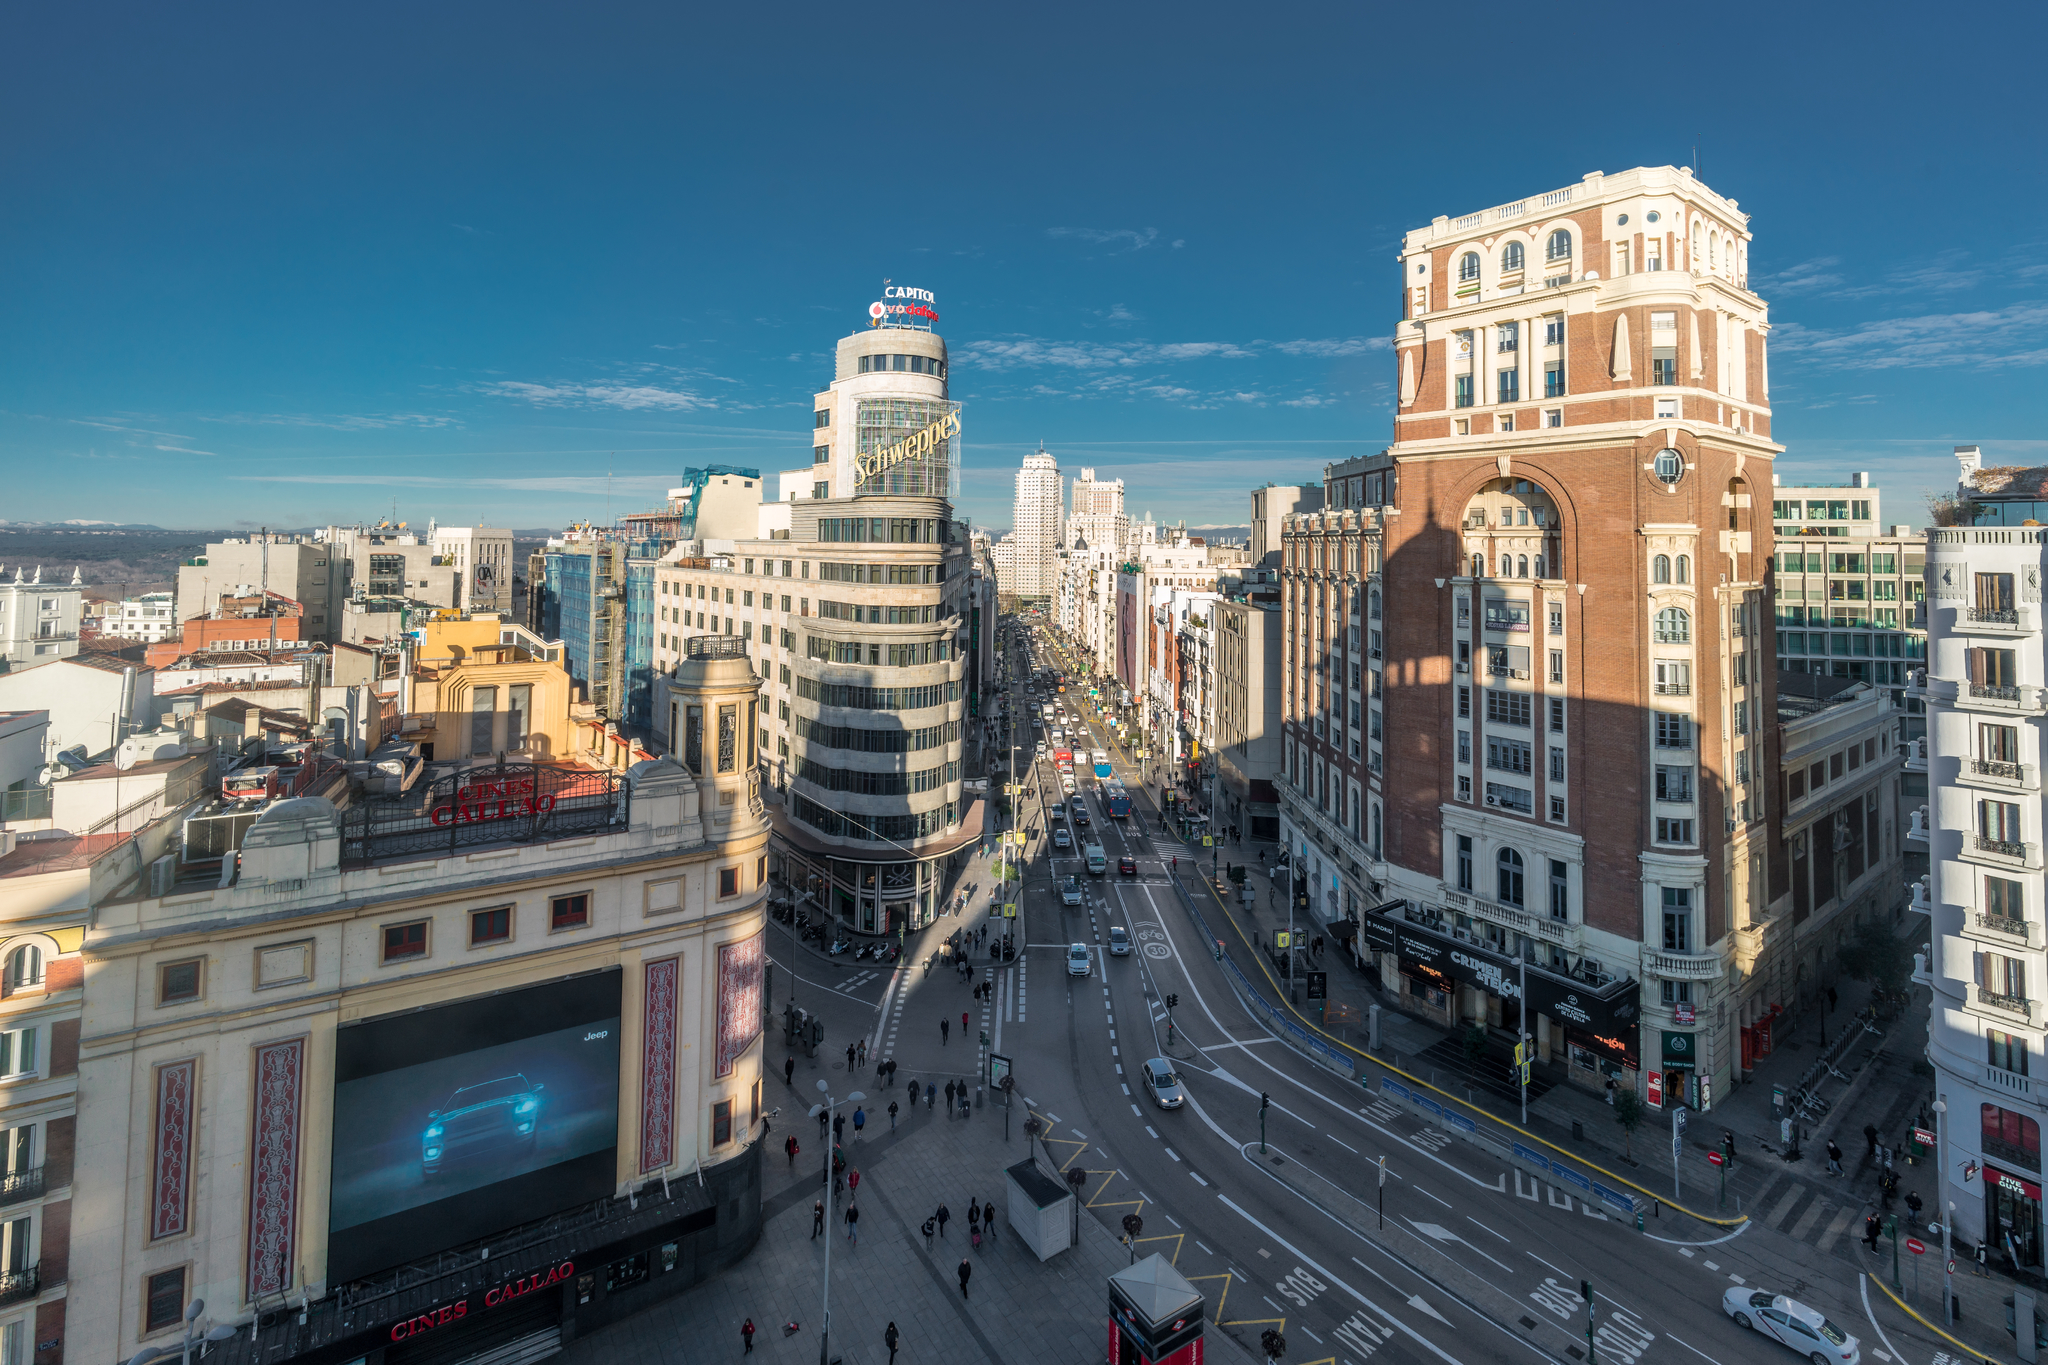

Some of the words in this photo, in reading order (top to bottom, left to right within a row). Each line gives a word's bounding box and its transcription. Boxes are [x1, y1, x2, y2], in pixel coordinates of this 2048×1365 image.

[884, 286, 936, 304] CAPITOL
[886, 302, 940, 322] vodafone
[854, 408, 961, 486] Schweppes
[458, 778, 534, 801] CINES
[432, 794, 556, 826] CALLAO
[1372, 923, 1393, 934] MADRID
[1150, 946, 1166, 955] 30
[1450, 951, 1502, 979] CRIMEN
[584, 1029, 608, 1041] Jeep
[1358, 1100, 1403, 1124] TAXI
[1410, 1127, 1452, 1152] BUS
[1999, 1181, 2025, 1194] GUYS
[2000, 1175, 2022, 1188] FIVE
[1275, 1266, 1328, 1307] BUS
[390, 1300, 468, 1342] CINES
[485, 1262, 574, 1308] CALLAO
[1529, 1278, 1585, 1320] BUS
[1332, 1310, 1394, 1359] TAXI
[1593, 1312, 1655, 1364] SOLO
